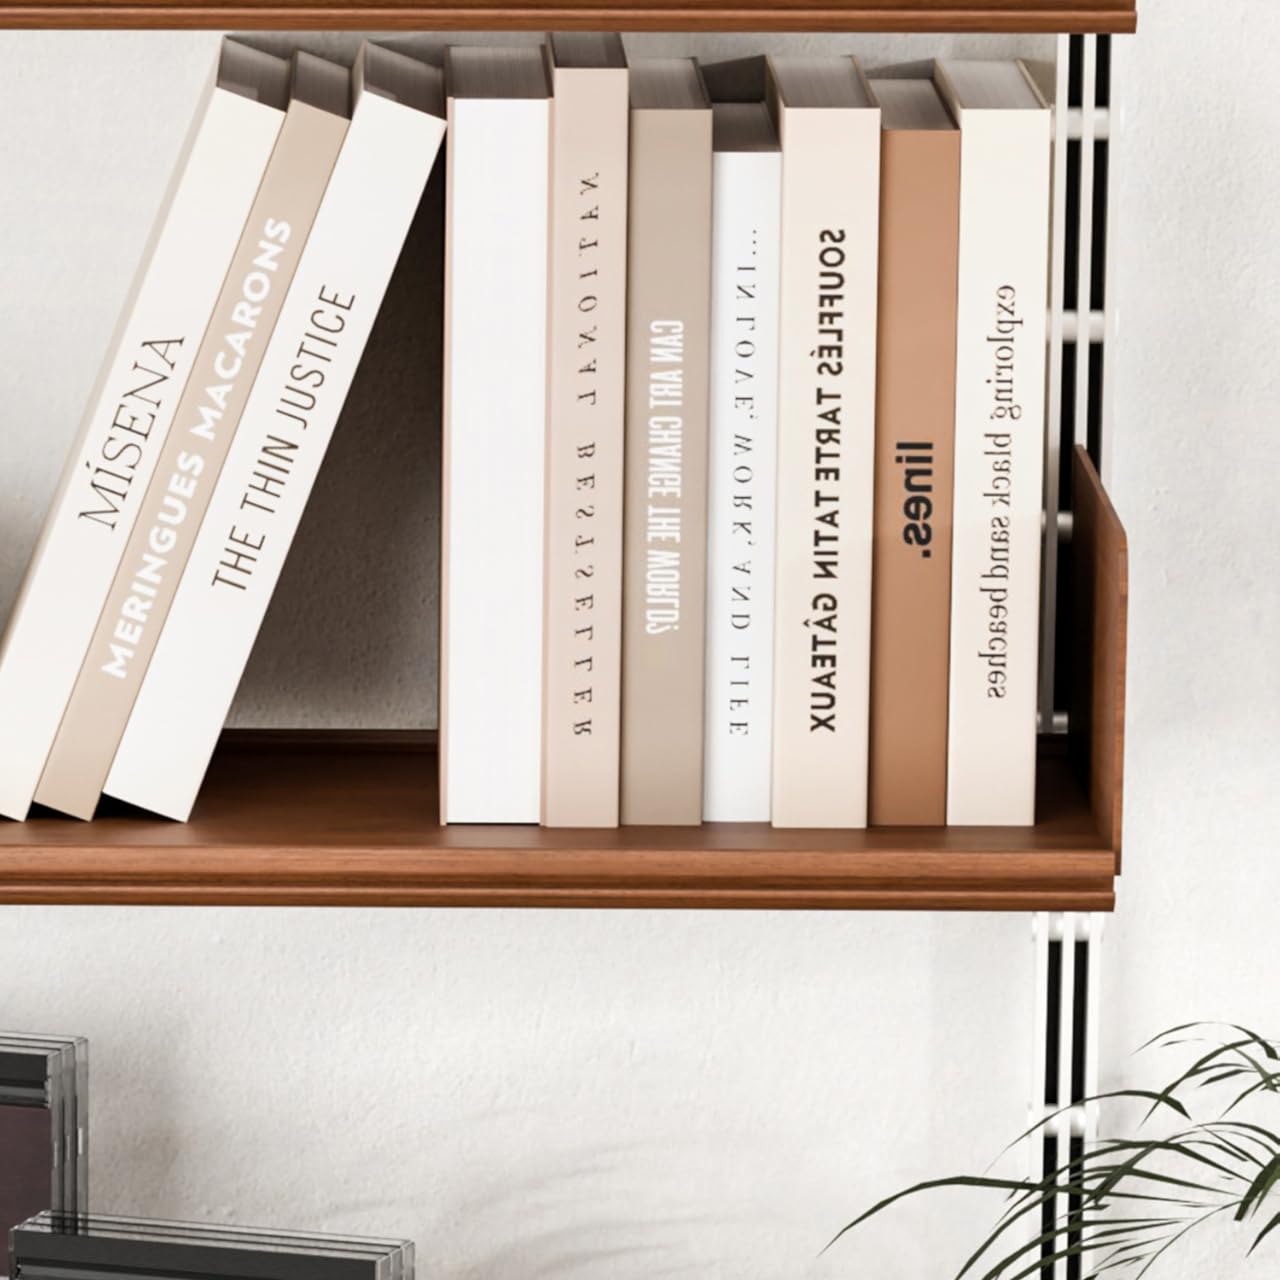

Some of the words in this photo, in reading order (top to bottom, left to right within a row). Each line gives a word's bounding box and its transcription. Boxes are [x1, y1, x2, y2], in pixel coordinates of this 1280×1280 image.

[78, 333, 186, 531] MÍSENA
[100, 449, 204, 680] MERINGUES
[190, 214, 293, 442] MACARONS
[211, 525, 267, 592] THE
[240, 430, 298, 514] THIN
[275, 284, 356, 429] JUSTICE
